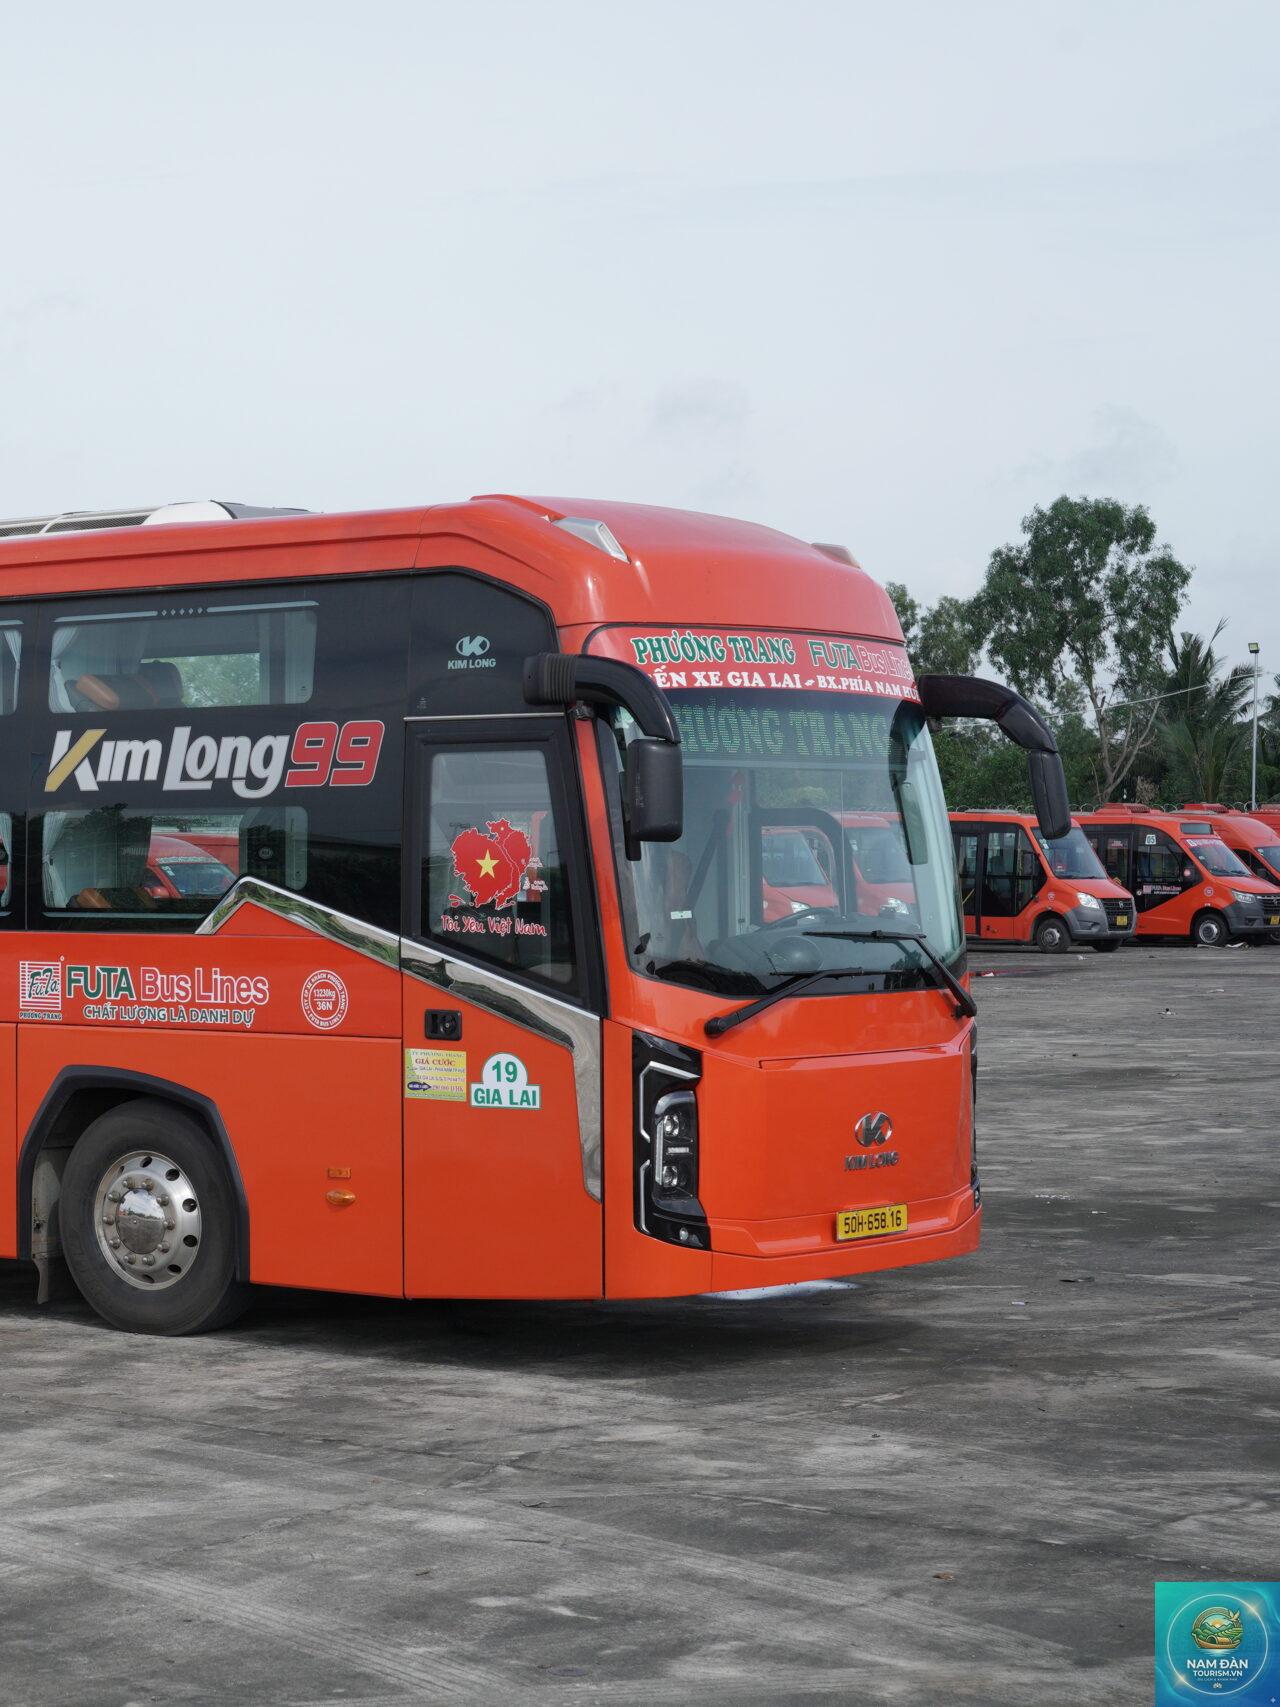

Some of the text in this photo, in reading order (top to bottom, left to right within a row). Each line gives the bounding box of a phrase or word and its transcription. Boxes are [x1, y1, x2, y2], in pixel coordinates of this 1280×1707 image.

[630, 630, 727, 665] PHƯƠNG
[726, 635, 796, 665] TRANG
[807, 640, 861, 670] FUTA
[448, 658, 496, 669] KIM LONG
[648, 665, 688, 688] ẾN
[692, 671, 723, 687] XE
[727, 671, 766, 687] GIA
[769, 672, 802, 689] LAI
[817, 675, 874, 693] BX.PHÍA
[875, 681, 902, 697] NAM
[672, 697, 893, 757] HƯƠNG TRANG
[441, 915, 547, 937] Tôi Yêu Việt Nam
[66, 965, 137, 1001] FUTA
[83, 1001, 256, 1028] CHẤT LƯỢNG LÀ DANH DỰ
[316, 1001, 333, 1010] 36N
[492, 1061, 518, 1083] 19
[473, 1087, 537, 1107] GIA LAI
[845, 1151, 899, 1171] KIM LONG
[844, 1210, 902, 1234] 50H-658.16
